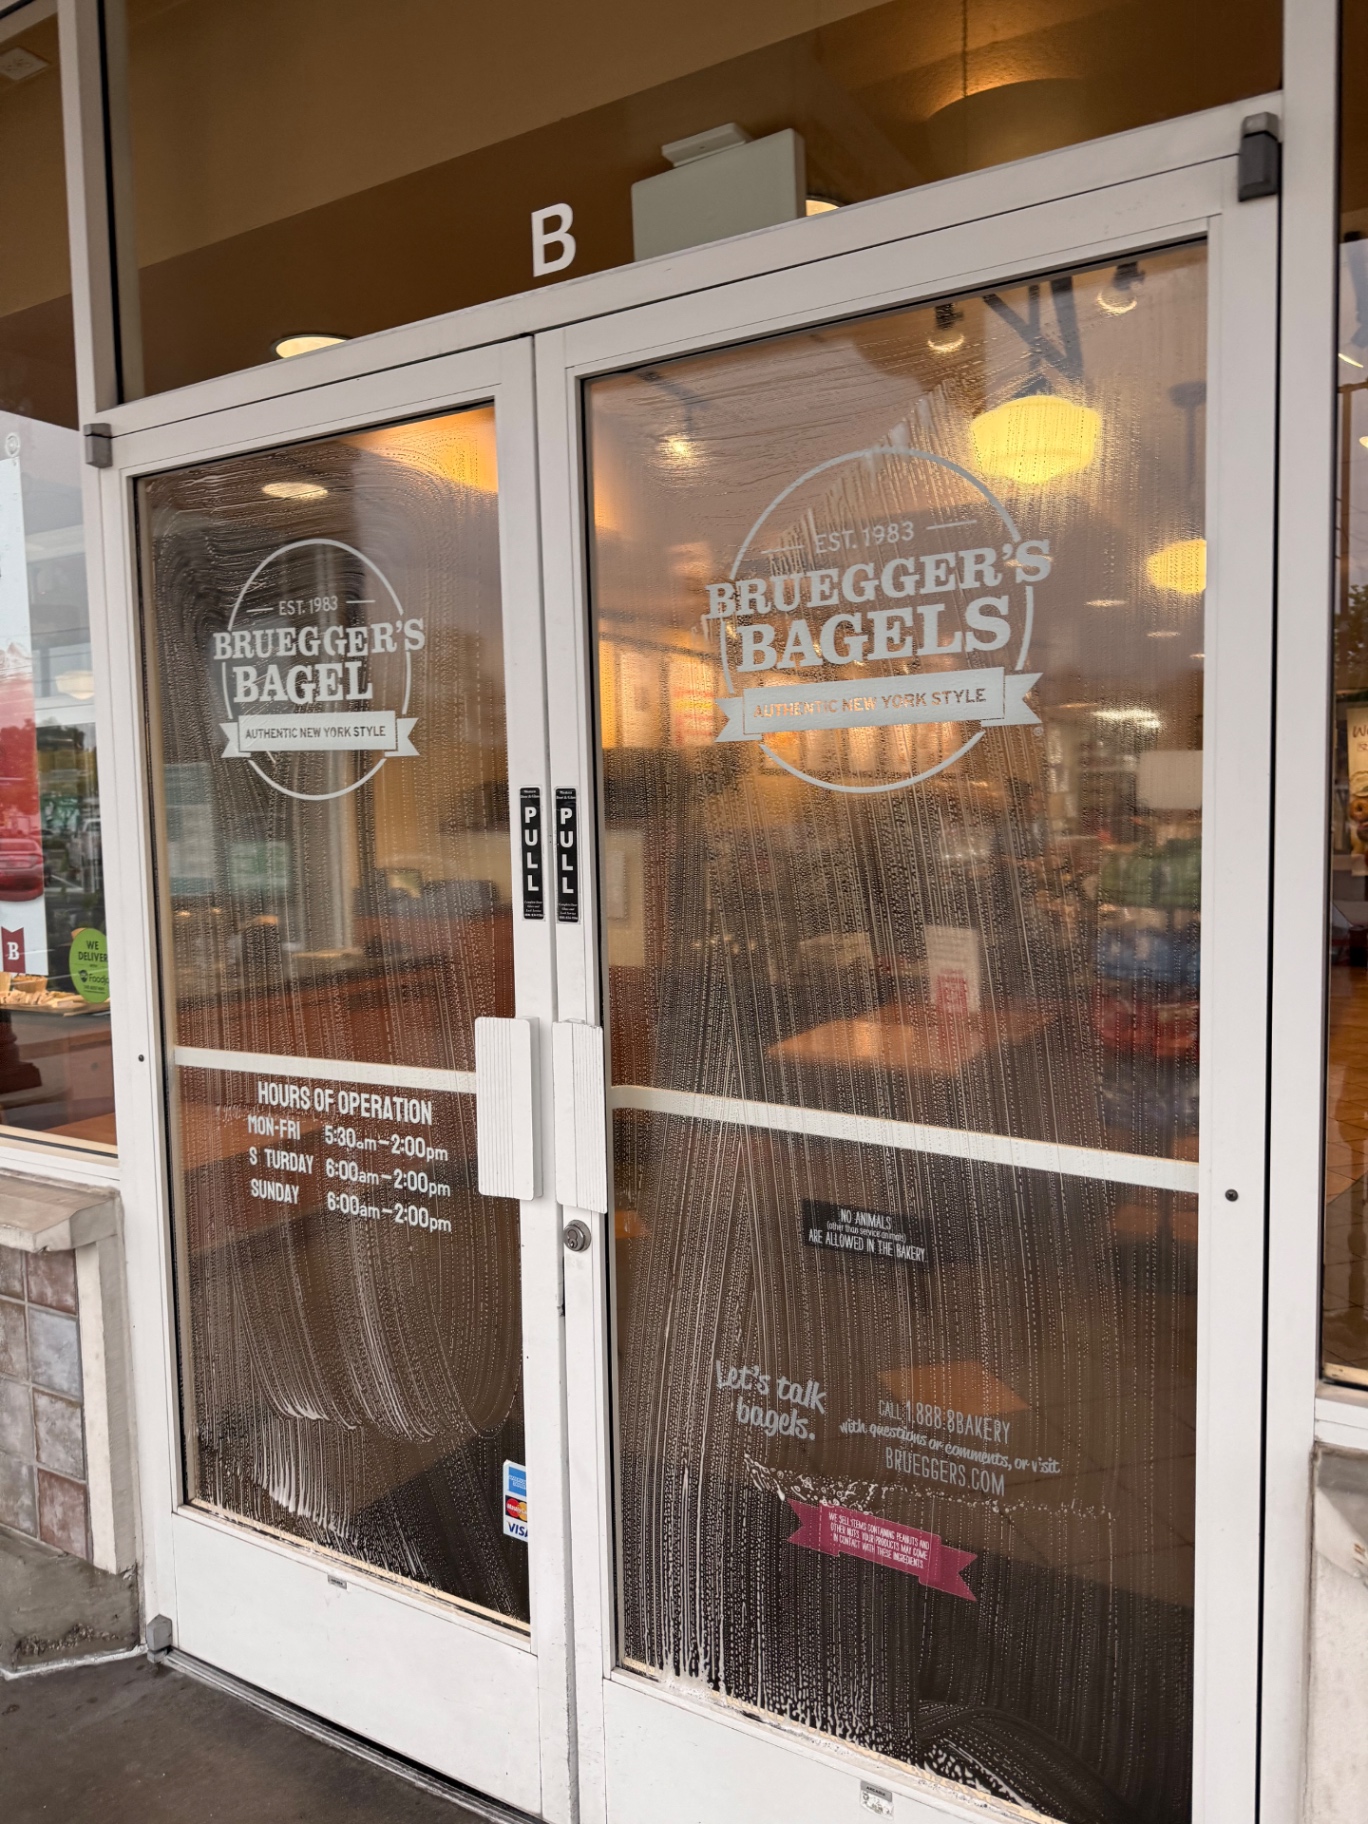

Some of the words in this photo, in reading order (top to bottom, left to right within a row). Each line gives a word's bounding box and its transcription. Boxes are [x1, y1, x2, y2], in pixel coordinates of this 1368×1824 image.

[531, 203, 576, 277] B
[815, 530, 858, 554] EST.
[863, 521, 914, 549] 1983
[704, 539, 1051, 619] BRUEGGER'S
[279, 600, 306, 615] EST.
[309, 596, 338, 614] 1983
[213, 618, 425, 660] BRUEGGER'S
[736, 595, 1011, 673] BAGELS
[233, 661, 373, 705] BAGEL
[753, 699, 838, 718] AUTHENTIC
[842, 696, 877, 712] NEW
[881, 692, 927, 709] YORK
[931, 688, 986, 705] STYLE
[245, 728, 298, 739] AUTHENTIC
[300, 727, 321, 738] NEW
[323, 726, 351, 738] YORK
[353, 725, 386, 737] STYLE
[525, 807, 539, 891] PULL
[560, 808, 574, 894] PULL
[7, 941, 20, 960] B
[78, 951, 108, 963] DELIVER
[87, 940, 99, 950] WE
[258, 1081, 310, 1110] HOURS
[314, 1088, 334, 1112] OF
[338, 1091, 432, 1125] OPERATION
[248, 1115, 300, 1140] MON-FRI
[251, 1178, 299, 1205] SUNDAY
[840, 1208, 852, 1223] NO
[855, 1211, 892, 1231] ANIMALS
[809, 1229, 823, 1244] ARE
[825, 1231, 864, 1251] ALLOWED
[867, 1238, 875, 1253] IN
[878, 1240, 893, 1256] THE
[716, 1360, 771, 1395] Let's
[778, 1376, 826, 1414] talk
[737, 1396, 815, 1440] bagels.
[879, 1400, 901, 1419] CALL
[905, 1401, 1010, 1444] 1.888.8BAKERY
[839, 1418, 867, 1434] with
[870, 1424, 927, 1446] questions
[929, 1438, 944, 1449] or
[945, 1443, 1012, 1471] comments,
[1015, 1458, 1029, 1470] or
[1031, 1456, 1060, 1474] visit
[886, 1447, 1005, 1496] BRUEGGERS.COM
[829, 1512, 837, 1522] WE
[839, 1515, 850, 1526] SELL
[920, 1539, 929, 1550] AND
[831, 1523, 845, 1534] OTHER
[875, 1536, 899, 1550] PRODUCTS
[840, 1535, 860, 1549] CONTACT
